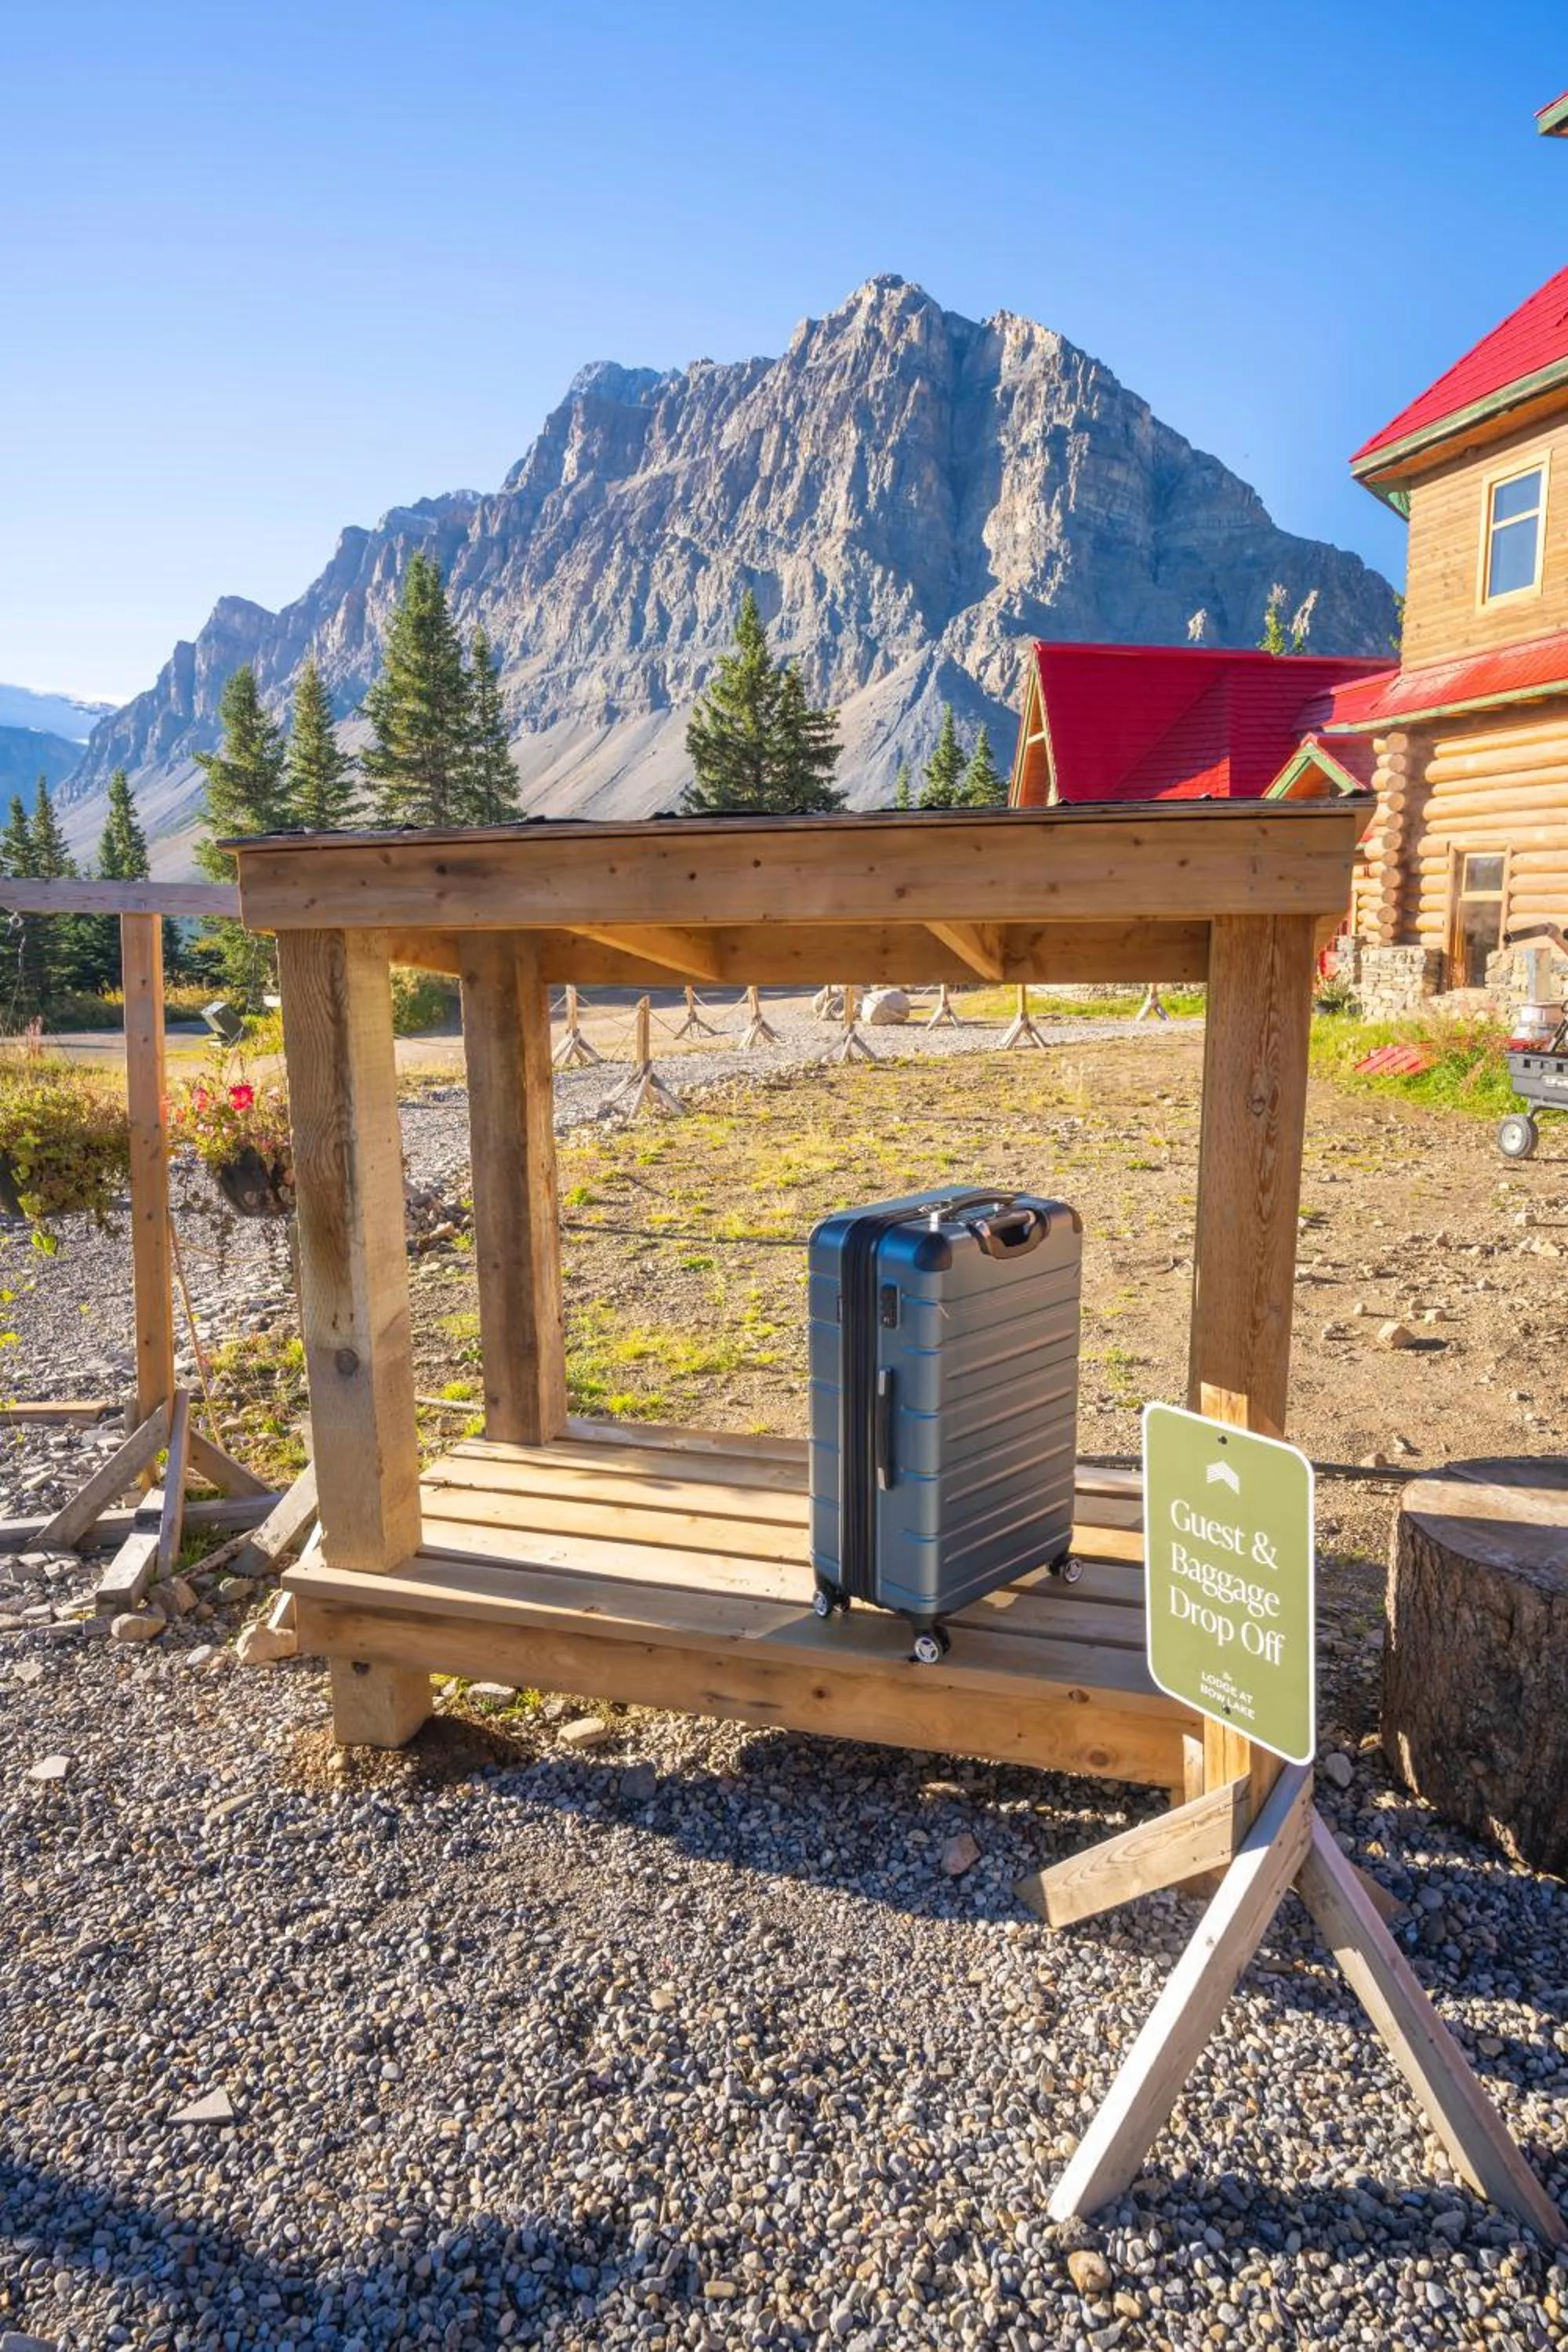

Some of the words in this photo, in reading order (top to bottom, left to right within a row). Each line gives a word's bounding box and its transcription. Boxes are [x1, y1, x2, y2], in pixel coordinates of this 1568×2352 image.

[1170, 1498, 1246, 1555] Guest
[1251, 1531, 1279, 1570] &
[1171, 1541, 1280, 1617] Baggage
[1170, 1584, 1235, 1646] Drop
[1241, 1621, 1286, 1666] Off
[1200, 1683, 1225, 1703] BOW
[1227, 1697, 1255, 1719] LAKE
[1201, 1671, 1237, 1697] LODGE
[1240, 1691, 1254, 1704] AT
